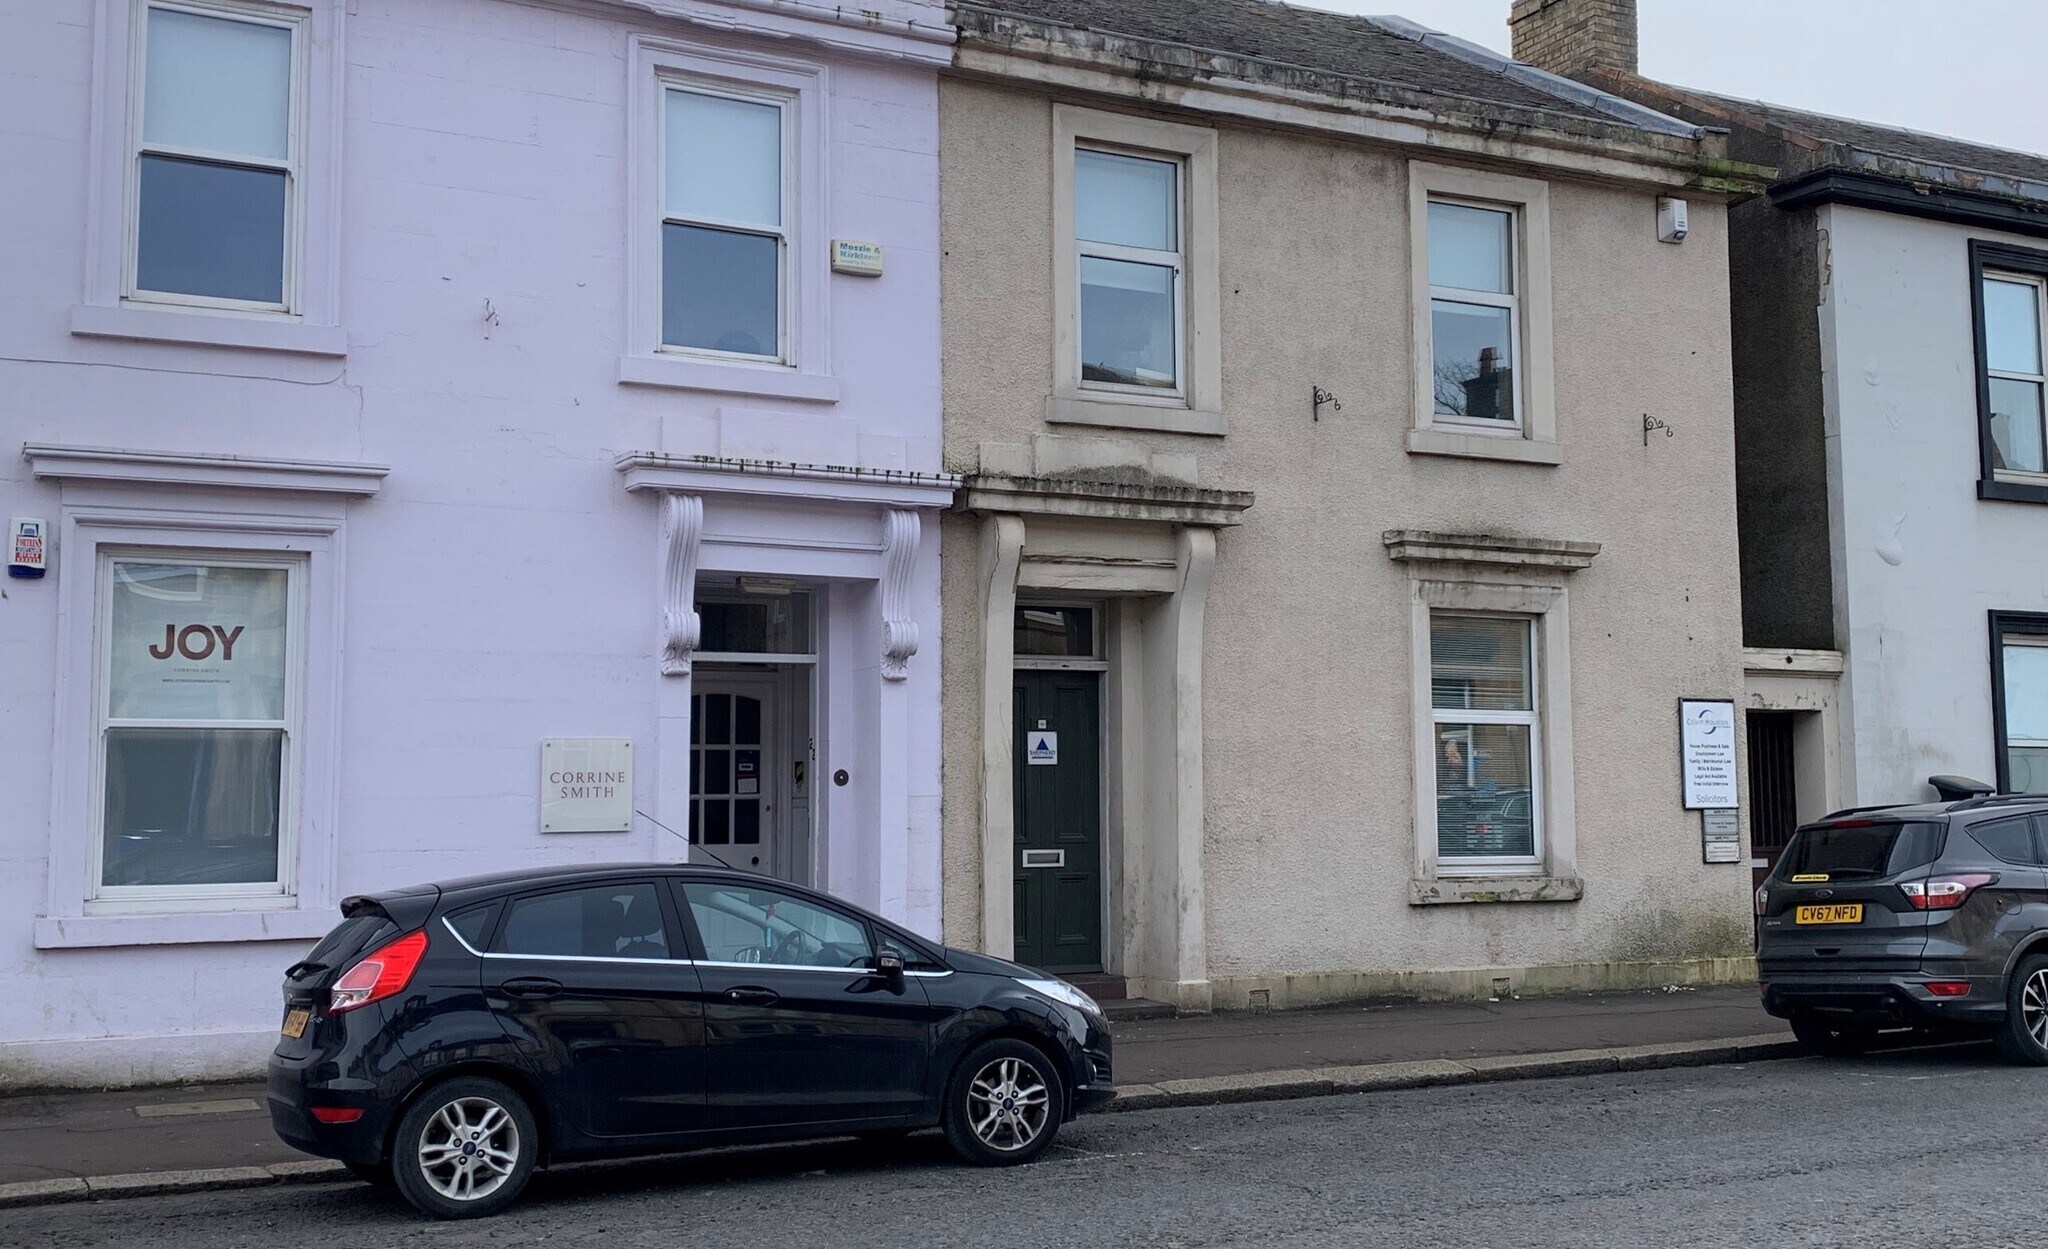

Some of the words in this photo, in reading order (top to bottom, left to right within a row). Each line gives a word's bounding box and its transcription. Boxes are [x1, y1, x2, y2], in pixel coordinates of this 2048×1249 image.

[149, 624, 245, 660] JOY
[549, 771, 625, 784] CORRINE
[560, 786, 613, 799] SMITH
[1696, 794, 1728, 804] Solicitors
[1801, 907, 1832, 921] CV67
[1834, 906, 1857, 920] NFD
